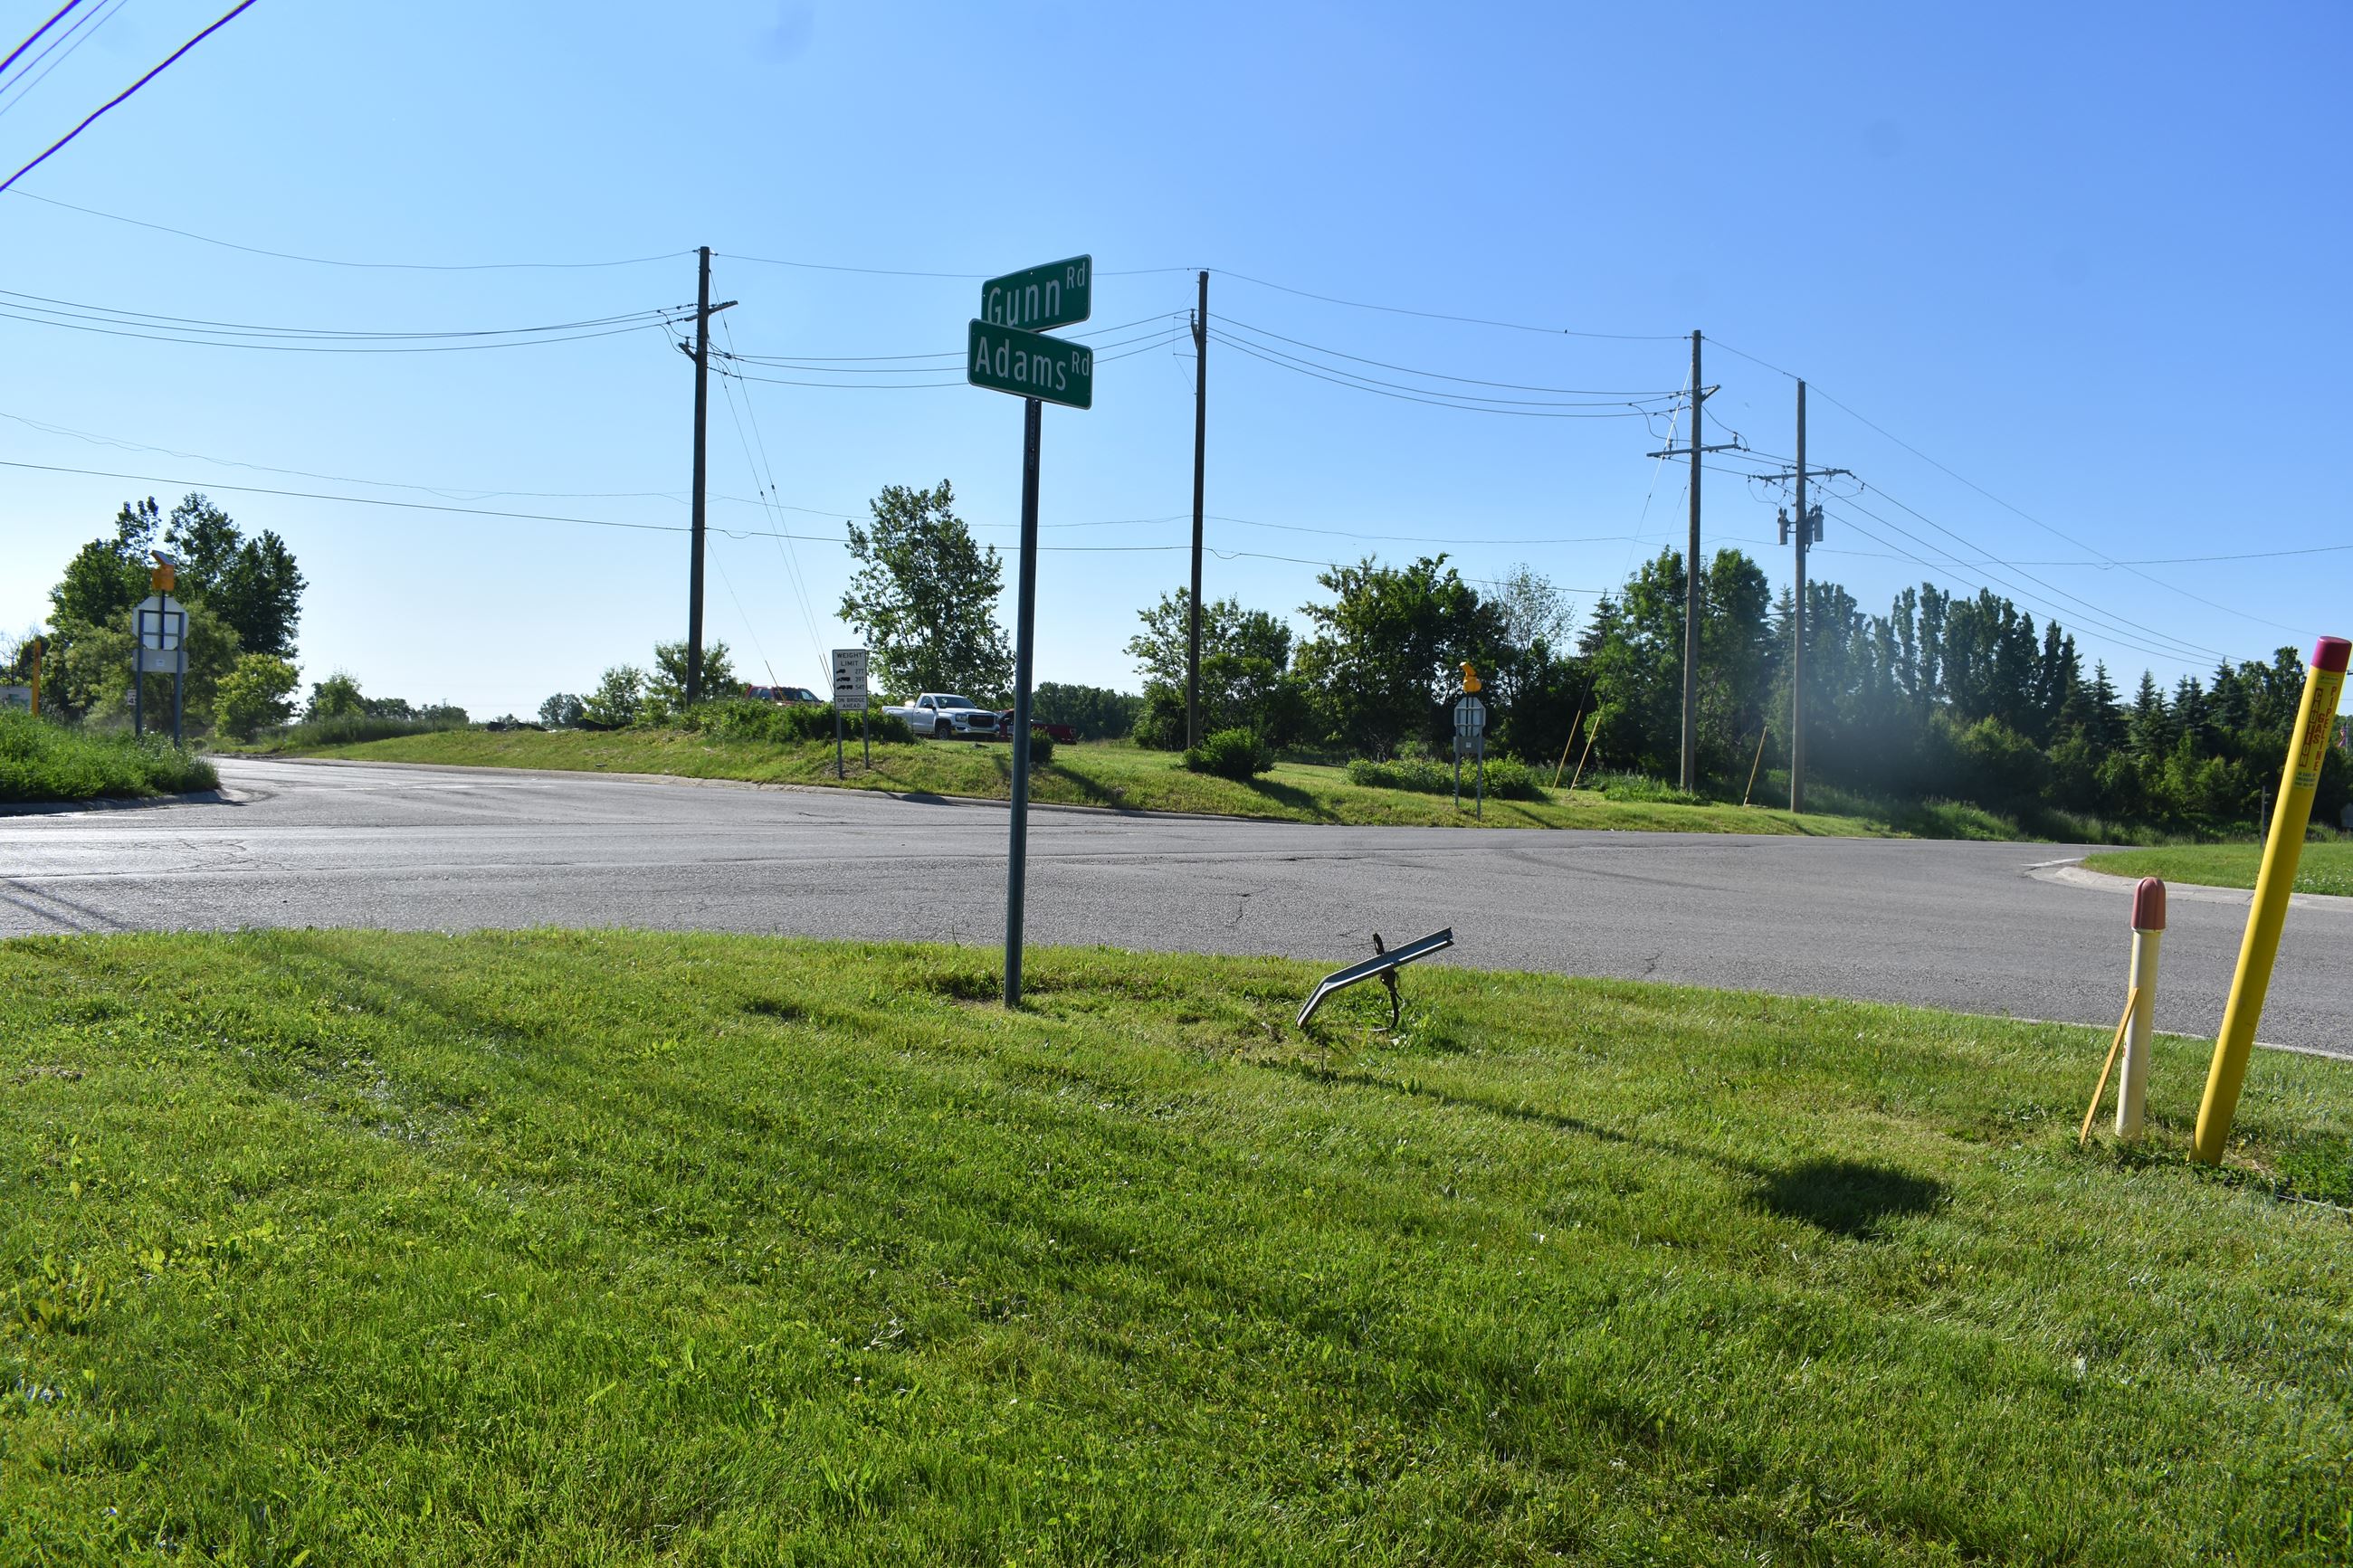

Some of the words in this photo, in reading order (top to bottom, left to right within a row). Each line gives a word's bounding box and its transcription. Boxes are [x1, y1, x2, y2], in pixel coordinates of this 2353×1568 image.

[987, 280, 1061, 327] Gunn
[1066, 261, 1085, 290] Rd
[975, 337, 1066, 391] Adams
[1072, 351, 1090, 376] Rd
[2299, 688, 2323, 767] CAUTION
[2313, 686, 2337, 771] PIPELINE
[2313, 713, 2325, 744] GAS
